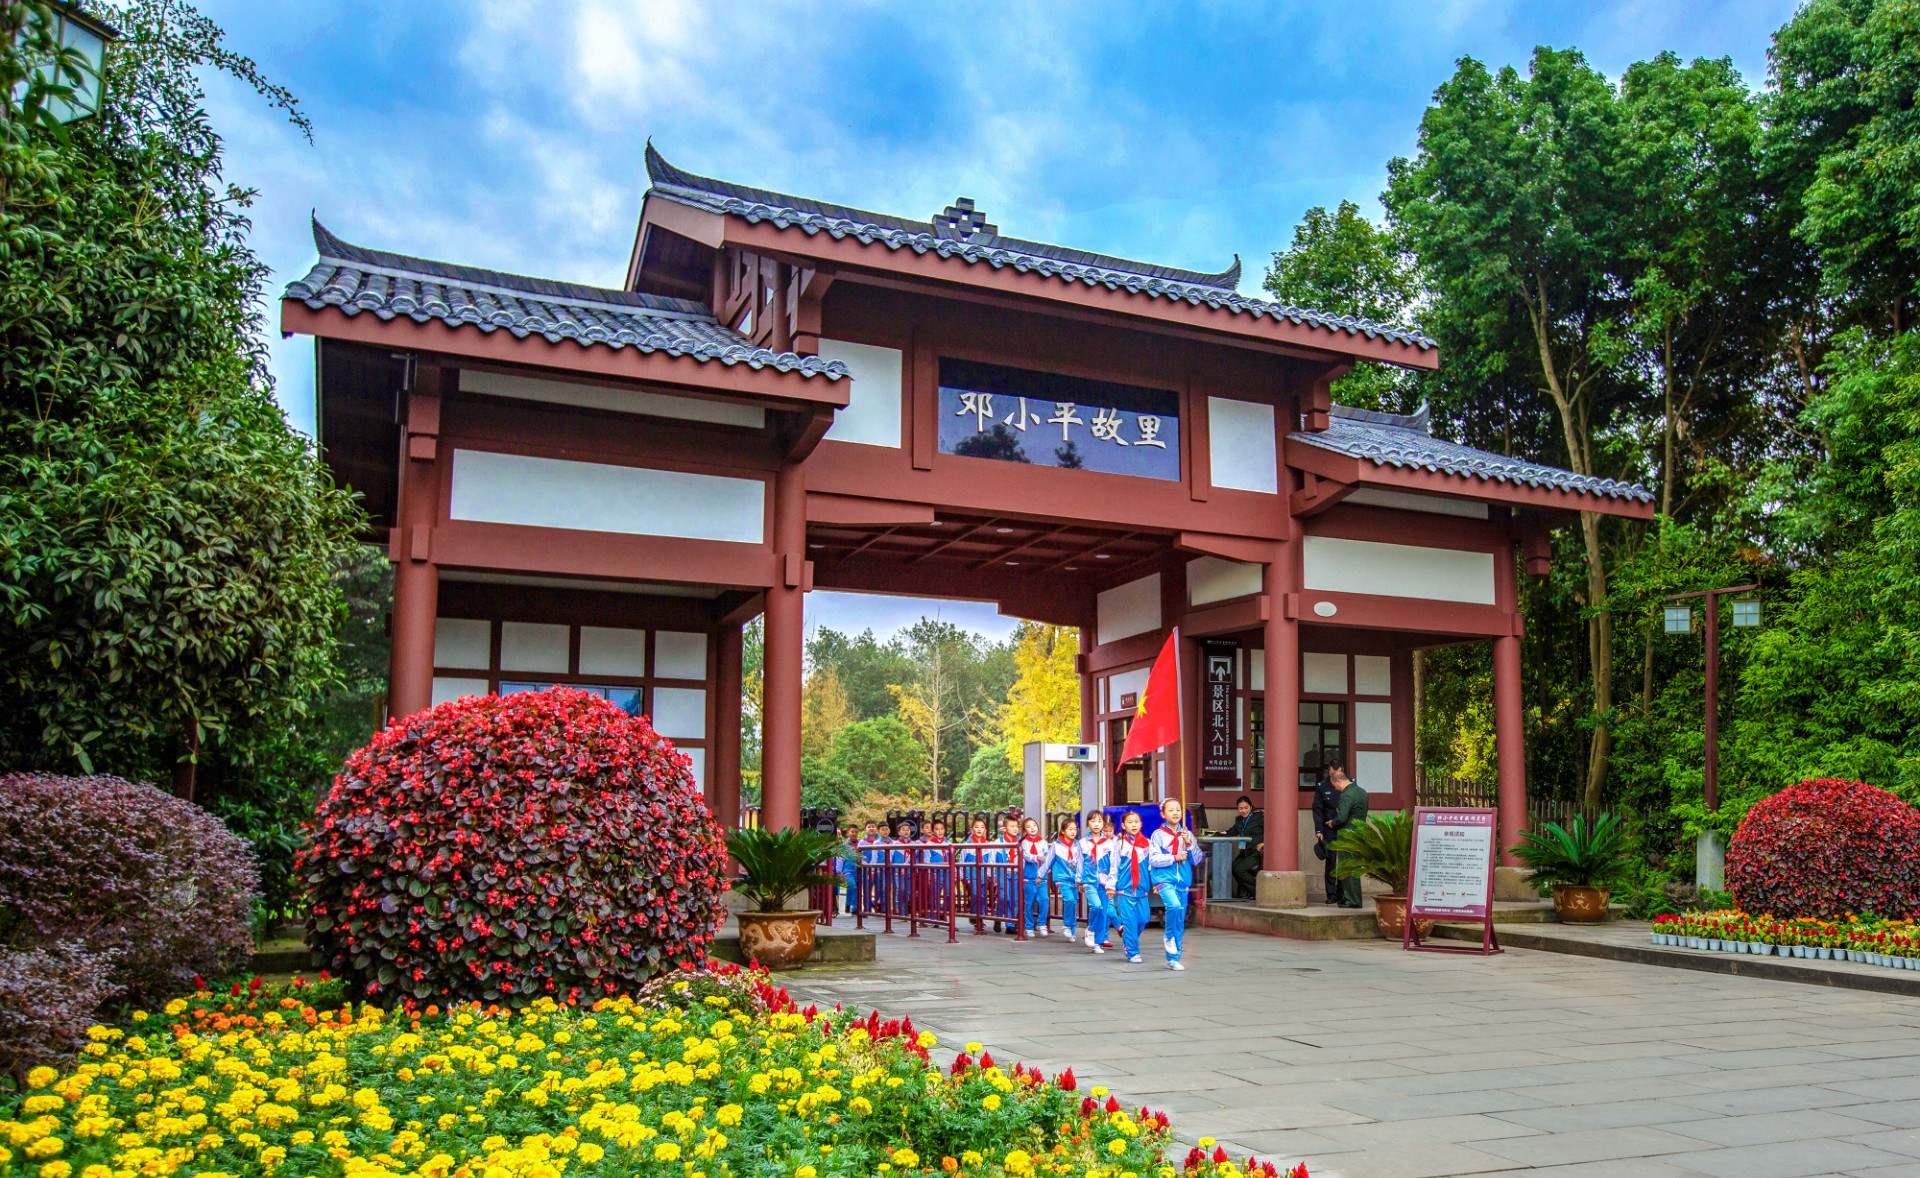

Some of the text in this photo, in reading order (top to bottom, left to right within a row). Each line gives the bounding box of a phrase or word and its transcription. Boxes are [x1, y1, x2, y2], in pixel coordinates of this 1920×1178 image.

[956, 392, 1167, 449] 邓小平故里
[1212, 684, 1225, 756] 景区北入口
